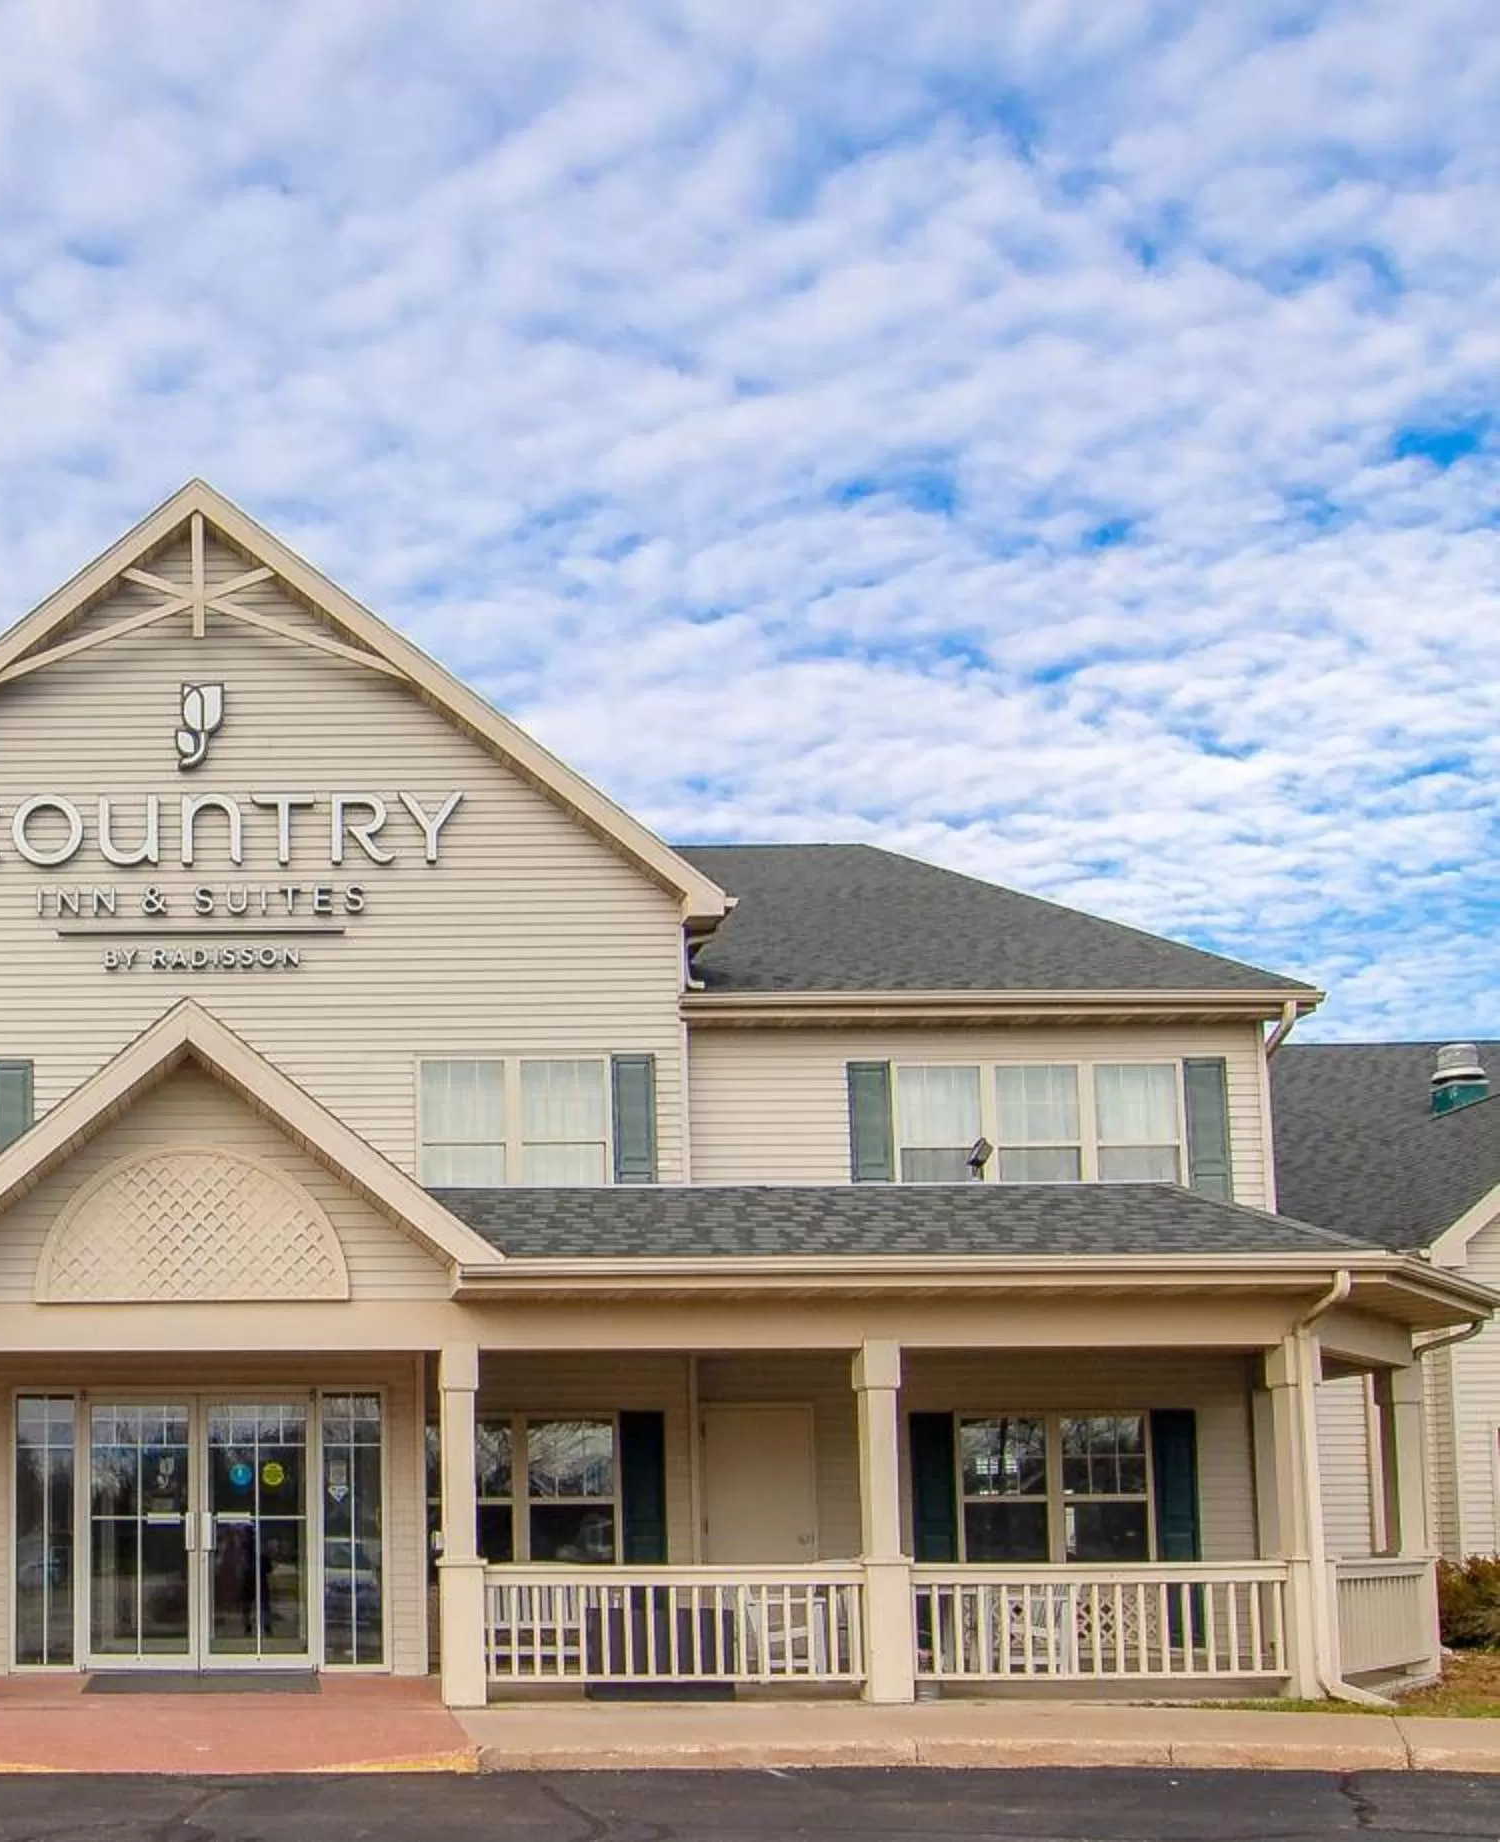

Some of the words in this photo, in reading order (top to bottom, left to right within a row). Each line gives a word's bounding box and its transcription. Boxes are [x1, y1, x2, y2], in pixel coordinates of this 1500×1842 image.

[36, 885, 117, 916] INN
[141, 885, 168, 915] &
[194, 885, 366, 915] SUITES
[103, 946, 137, 970] BY
[151, 946, 302, 970] RADISSON
